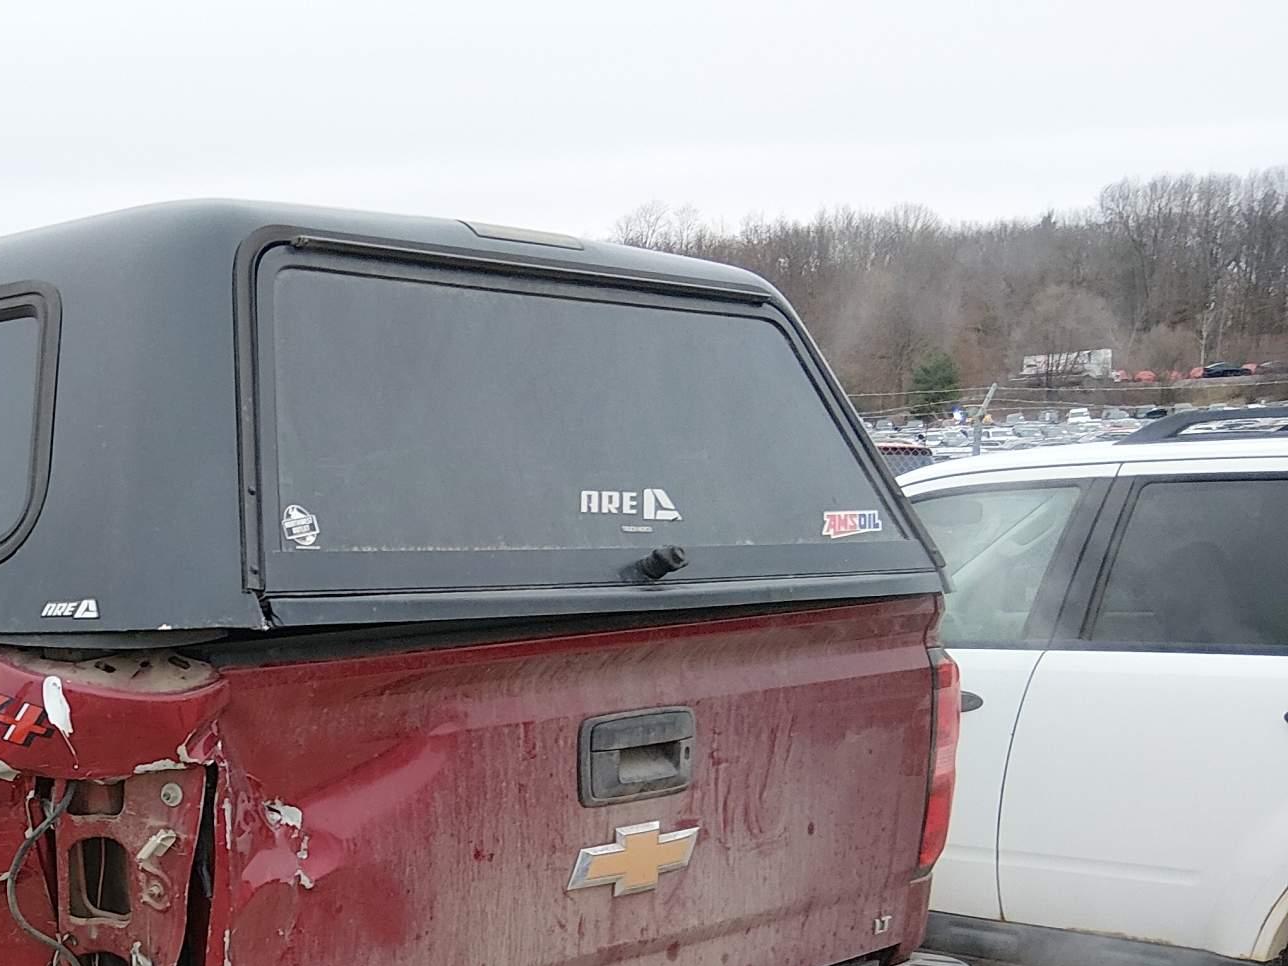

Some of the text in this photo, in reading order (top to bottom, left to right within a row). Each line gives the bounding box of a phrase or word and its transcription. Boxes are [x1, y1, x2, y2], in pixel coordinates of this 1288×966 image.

[580, 490, 638, 514] ARE
[824, 513, 880, 536] AMSOIL
[874, 915, 892, 935] LT
